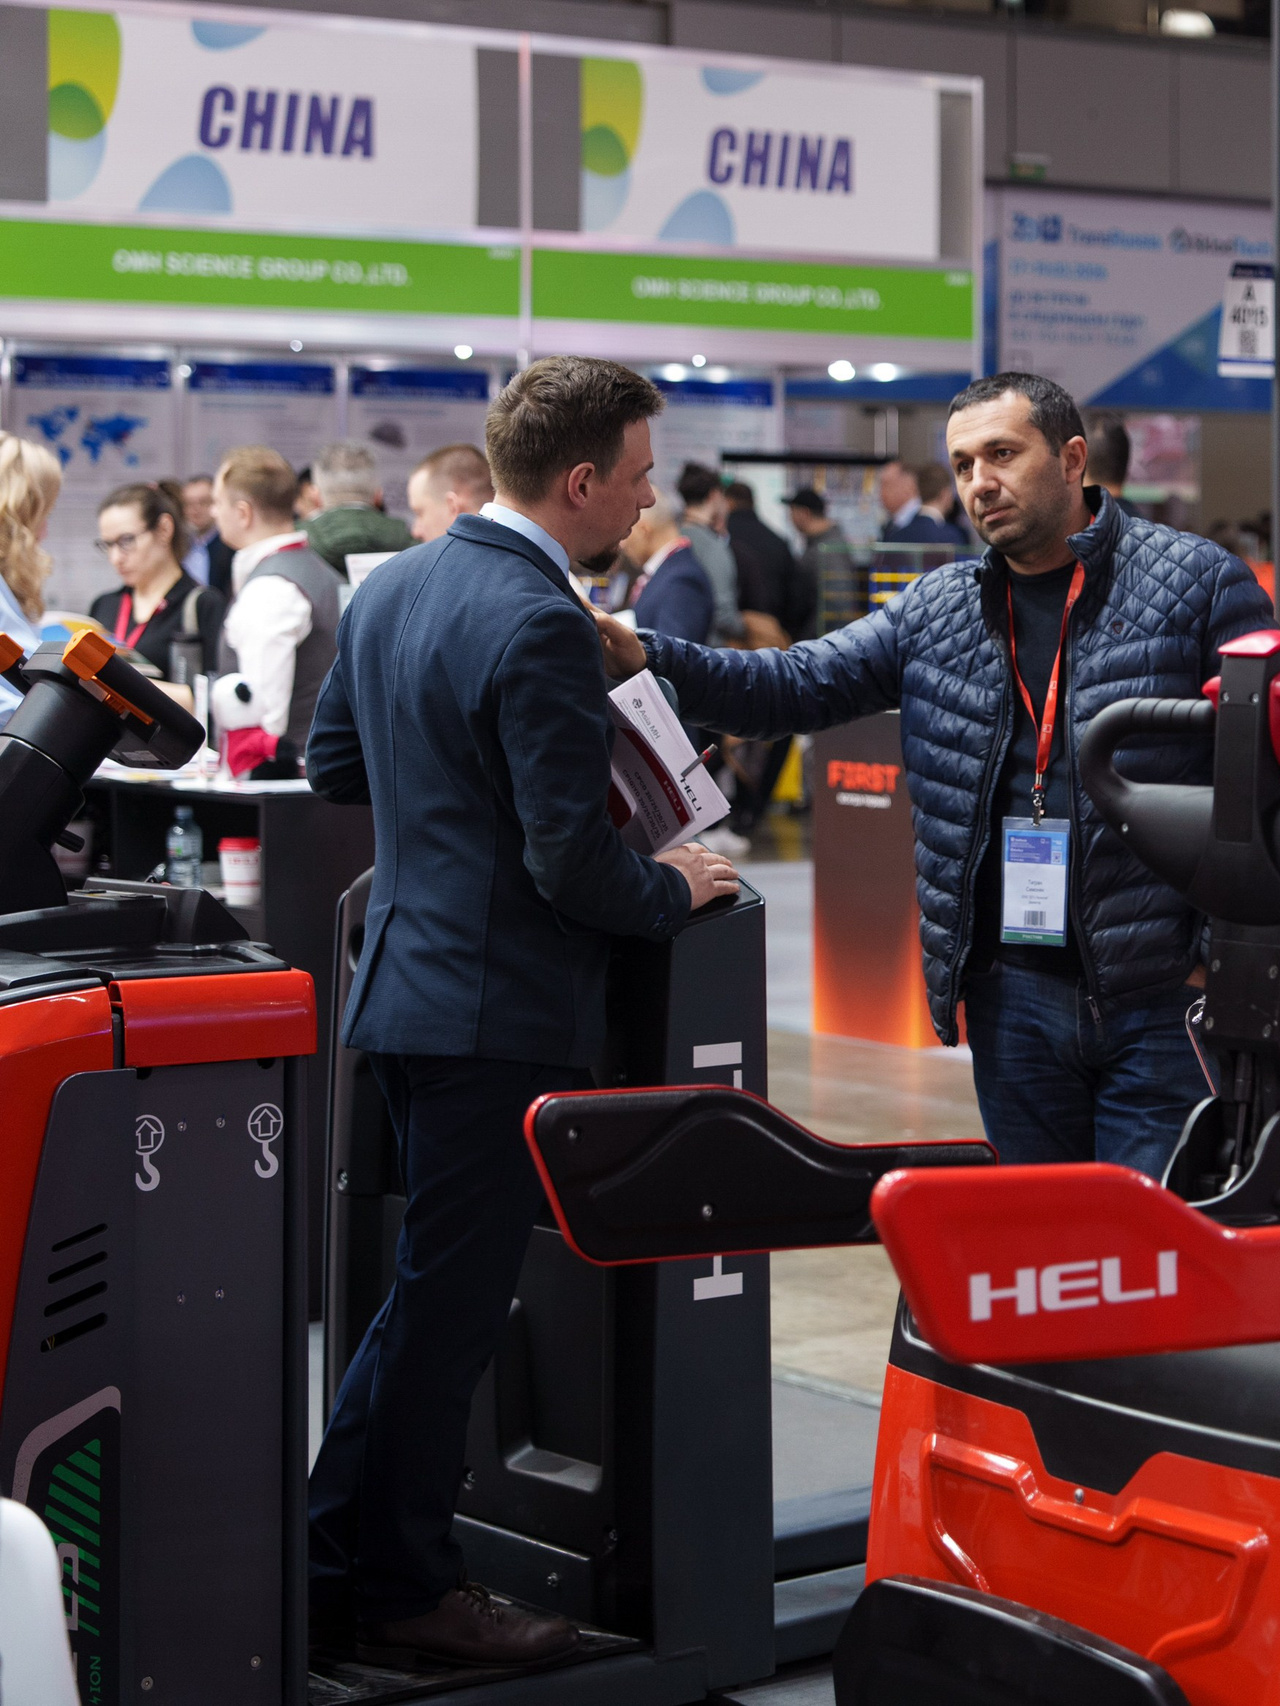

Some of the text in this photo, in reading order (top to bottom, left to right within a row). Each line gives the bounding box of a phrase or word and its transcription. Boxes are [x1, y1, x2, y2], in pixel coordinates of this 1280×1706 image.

[197, 85, 375, 160] CHINA
[705, 126, 854, 195] CHINA
[639, 709, 653, 727] Asia
[680, 777, 702, 812] HELI
[968, 1250, 1179, 1322] HELI
